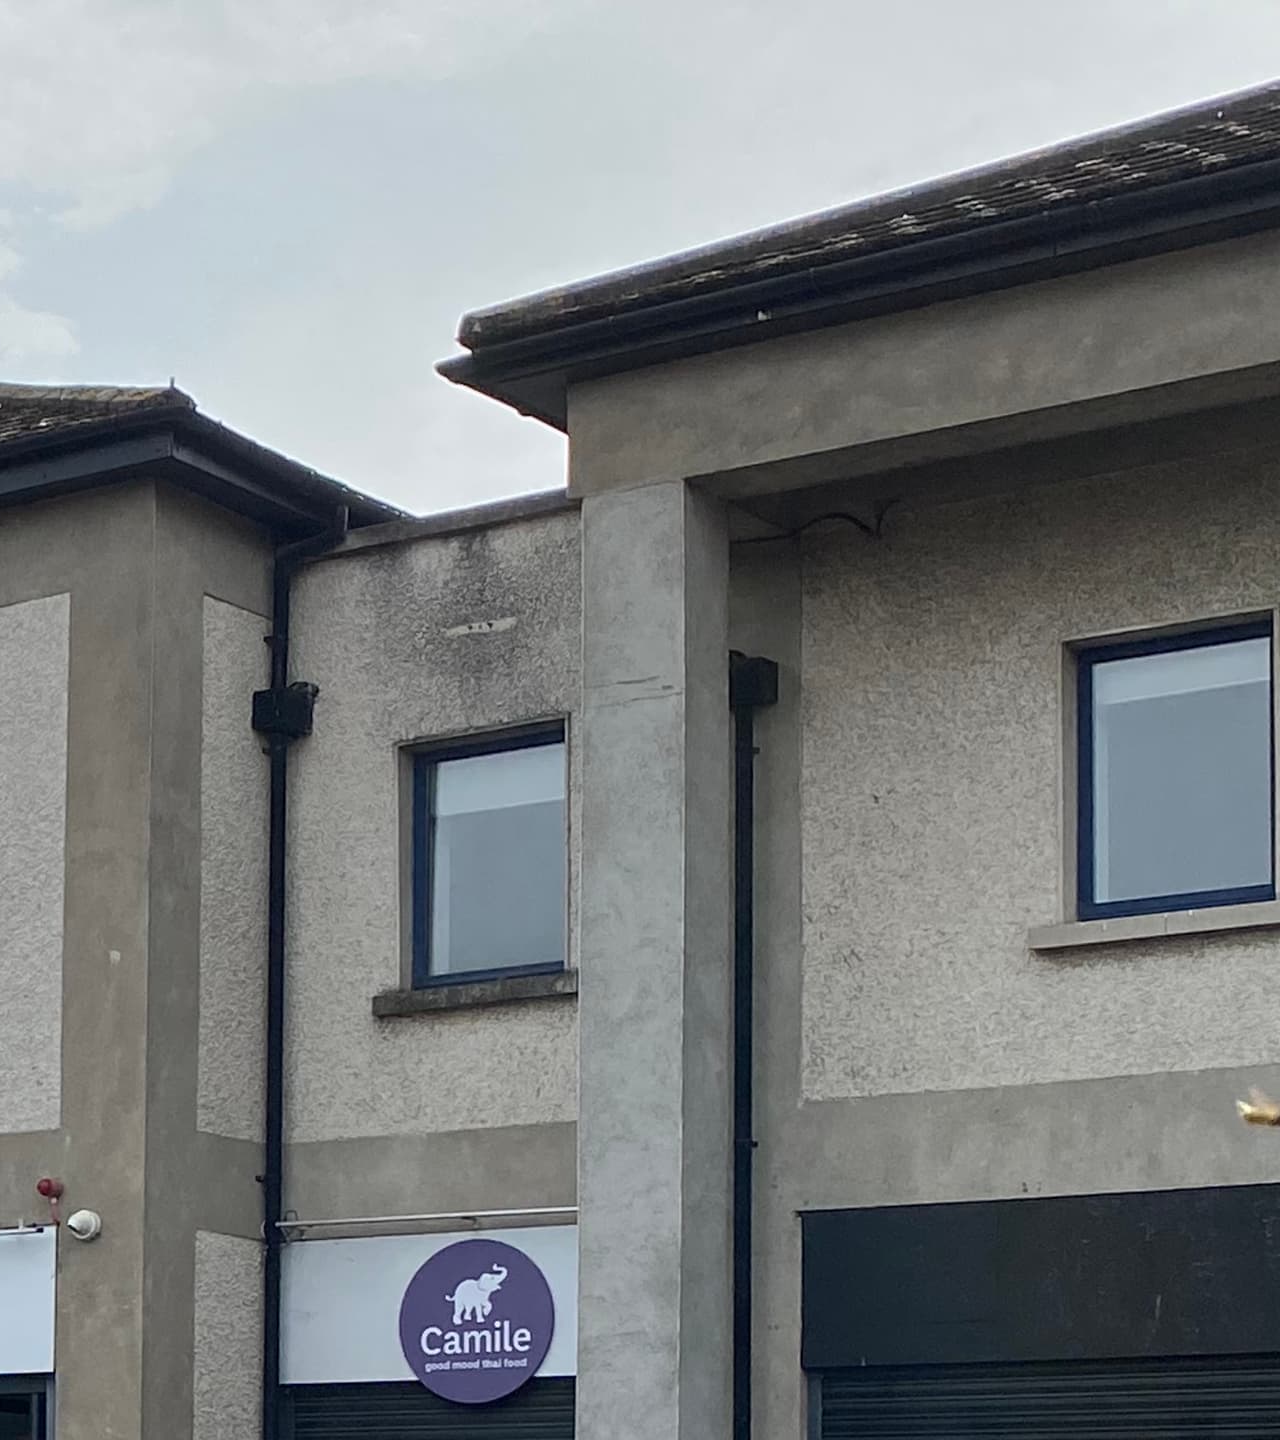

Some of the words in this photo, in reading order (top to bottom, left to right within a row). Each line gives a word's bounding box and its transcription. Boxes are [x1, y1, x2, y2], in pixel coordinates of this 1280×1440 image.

[420, 1320, 532, 1356] Camile
[424, 1360, 450, 1373] good
[452, 1359, 480, 1370] mood
[482, 1359, 502, 1369] thai
[504, 1357, 528, 1368] food
